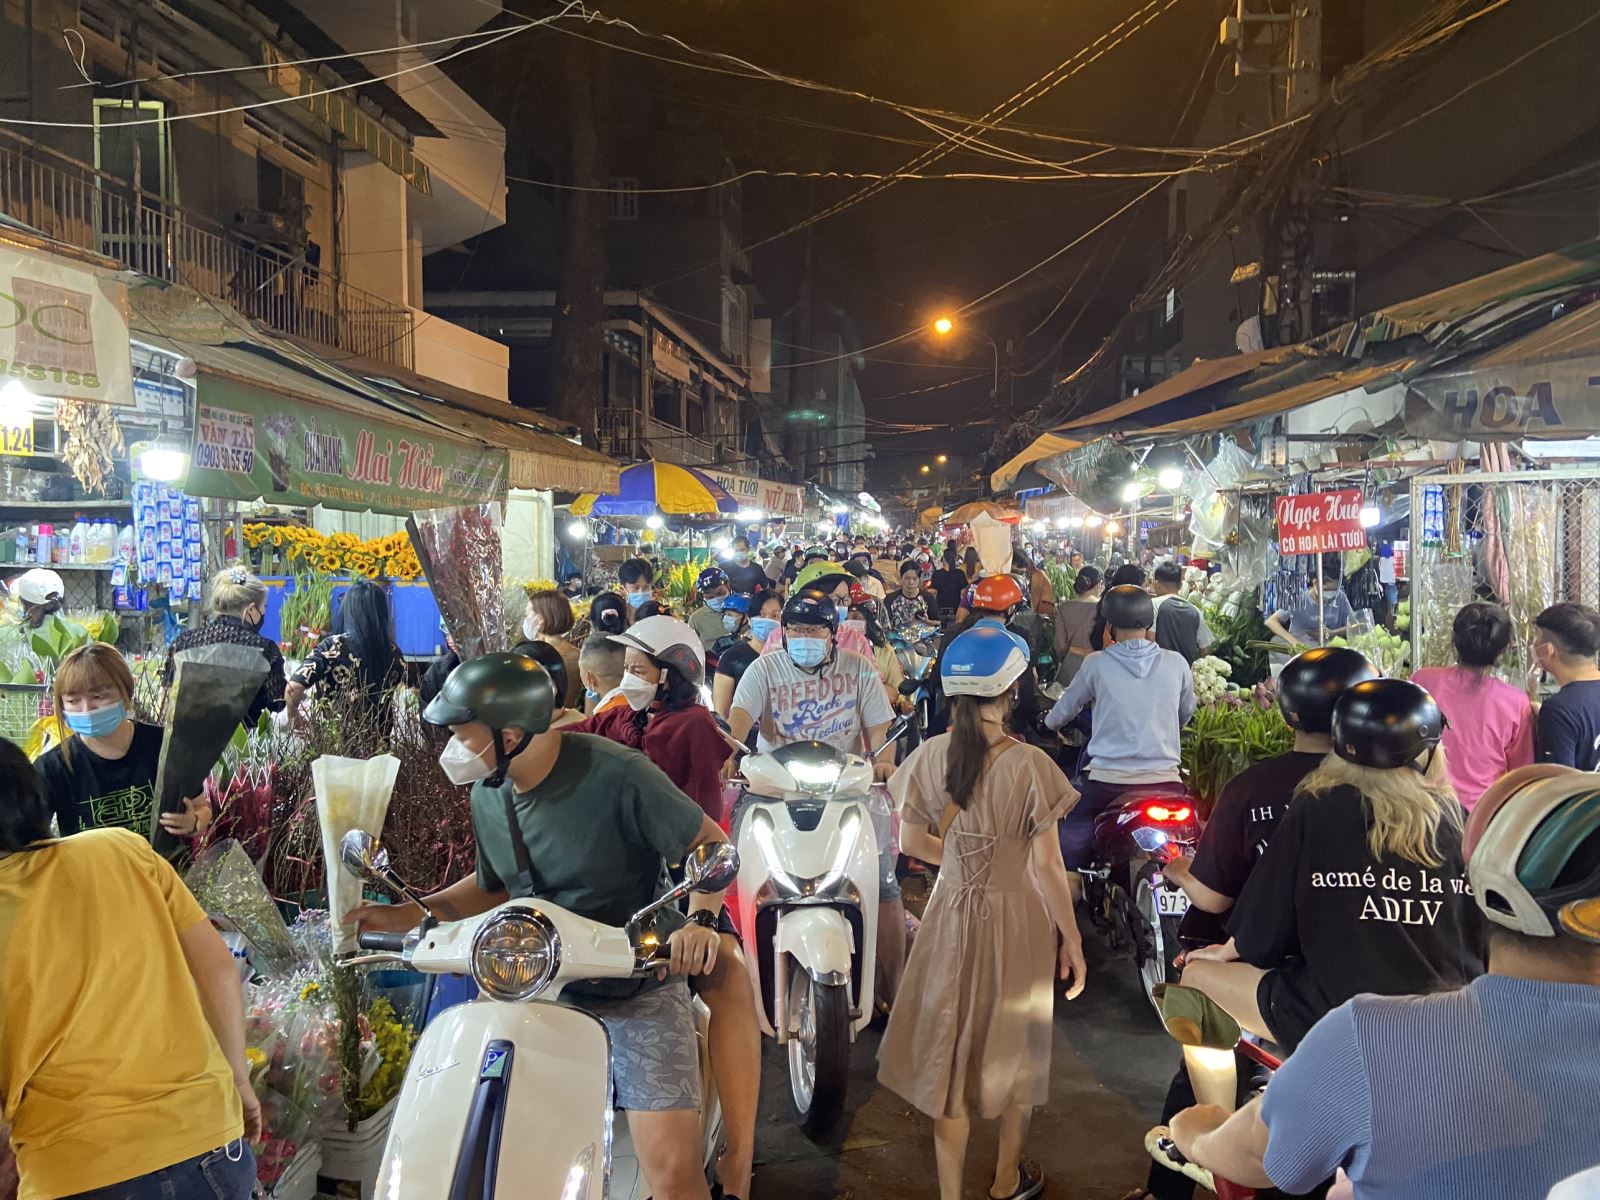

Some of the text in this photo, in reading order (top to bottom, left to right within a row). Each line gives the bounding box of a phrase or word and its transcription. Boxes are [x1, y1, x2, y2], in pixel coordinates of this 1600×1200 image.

[1444, 382, 1562, 429] HOA
[346, 429, 392, 486] Mai
[716, 475, 735, 492] HOA
[1279, 493, 1361, 530] Ngọc Huế
[1282, 529, 1364, 552] CÓ HOA LÀI TƯƠI
[768, 672, 860, 713] FREEDOM
[797, 693, 842, 721] Rock
[1312, 866, 1475, 896] acmé de la vie
[1359, 894, 1443, 926] ADLV
